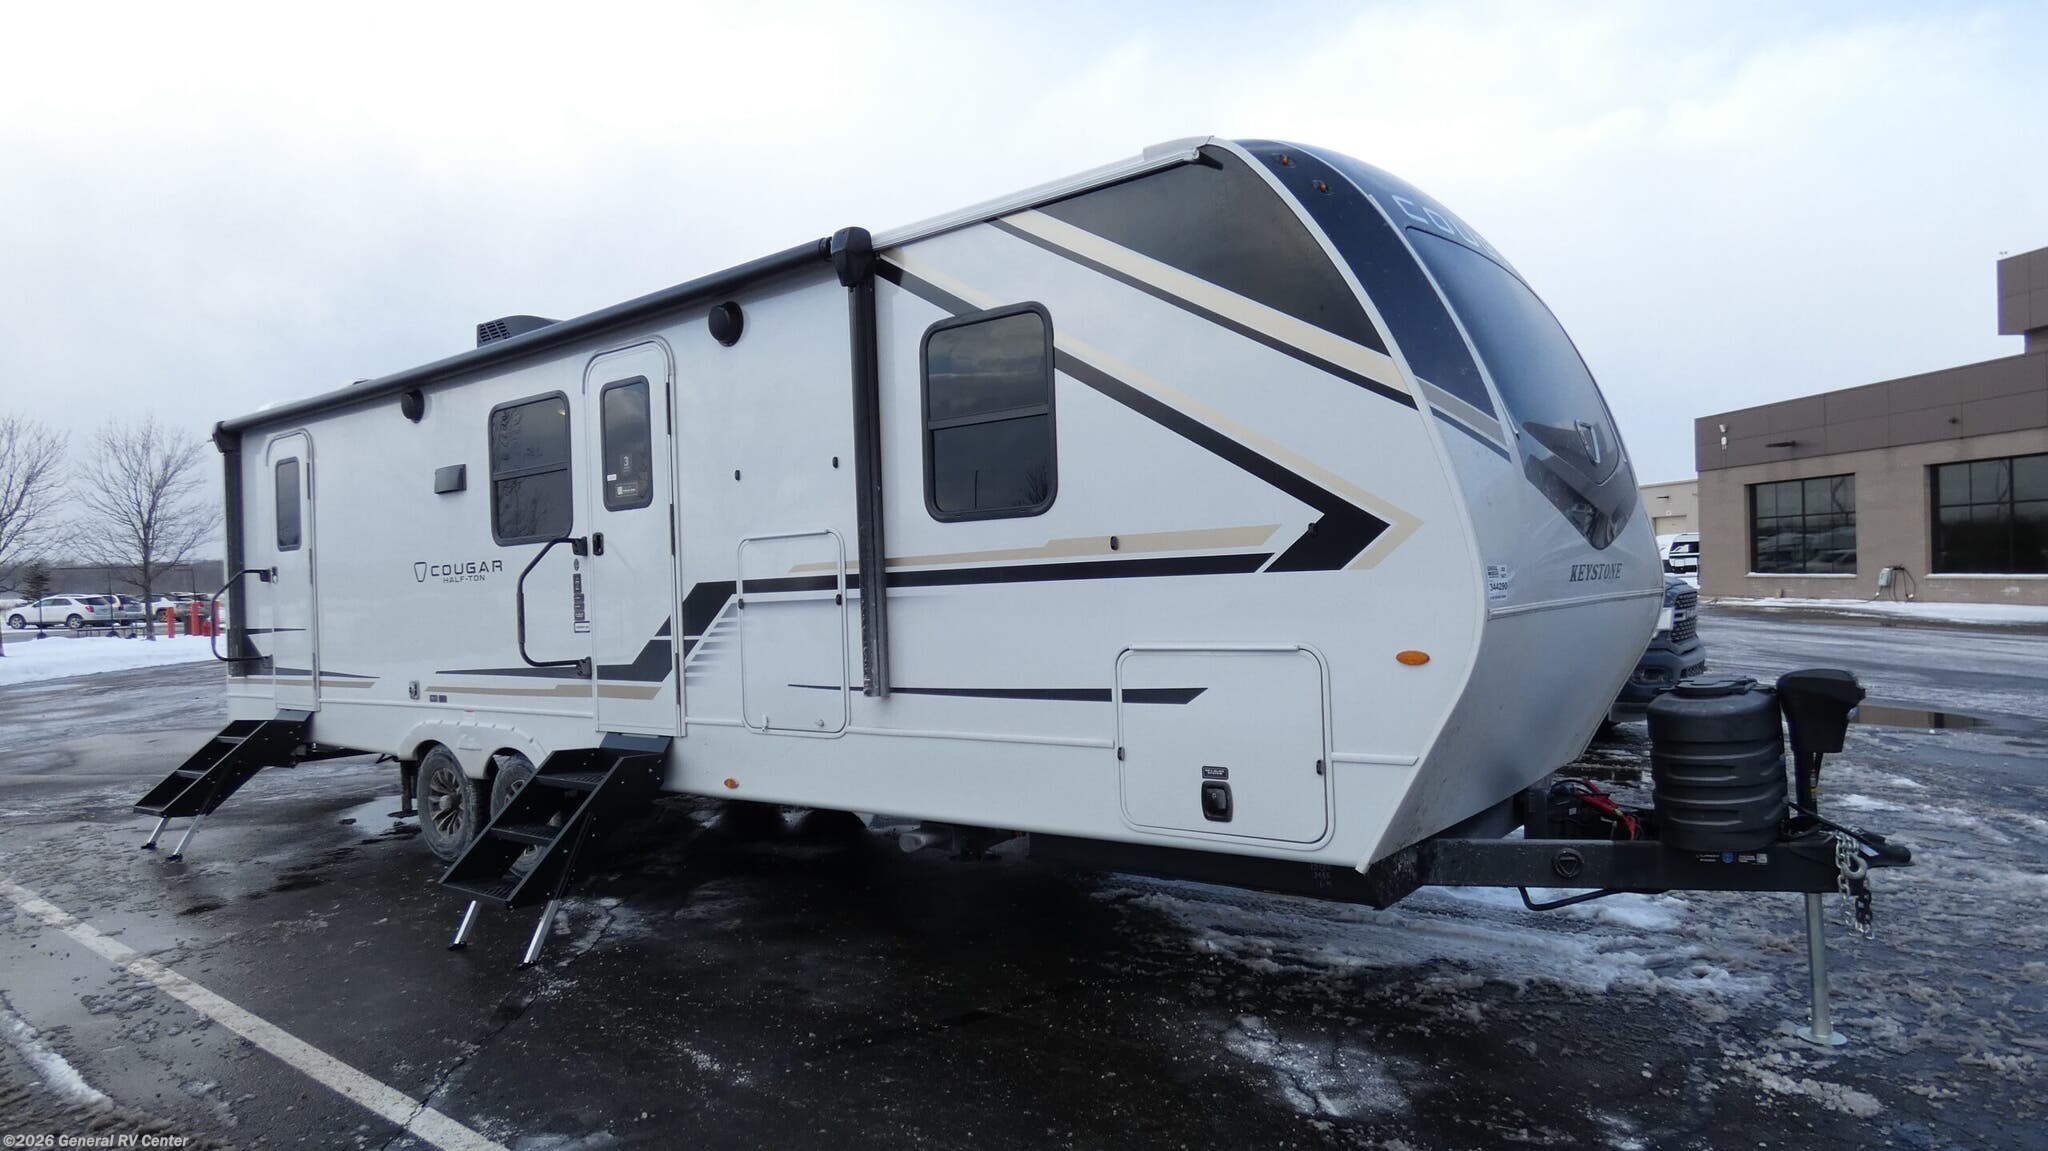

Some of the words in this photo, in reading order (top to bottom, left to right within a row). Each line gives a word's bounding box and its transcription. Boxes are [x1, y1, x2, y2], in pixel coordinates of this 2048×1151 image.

[431, 560, 503, 576] COUGAR
[1569, 562, 1623, 582] KEYSTONE
[443, 574, 486, 583] HALF-TON
